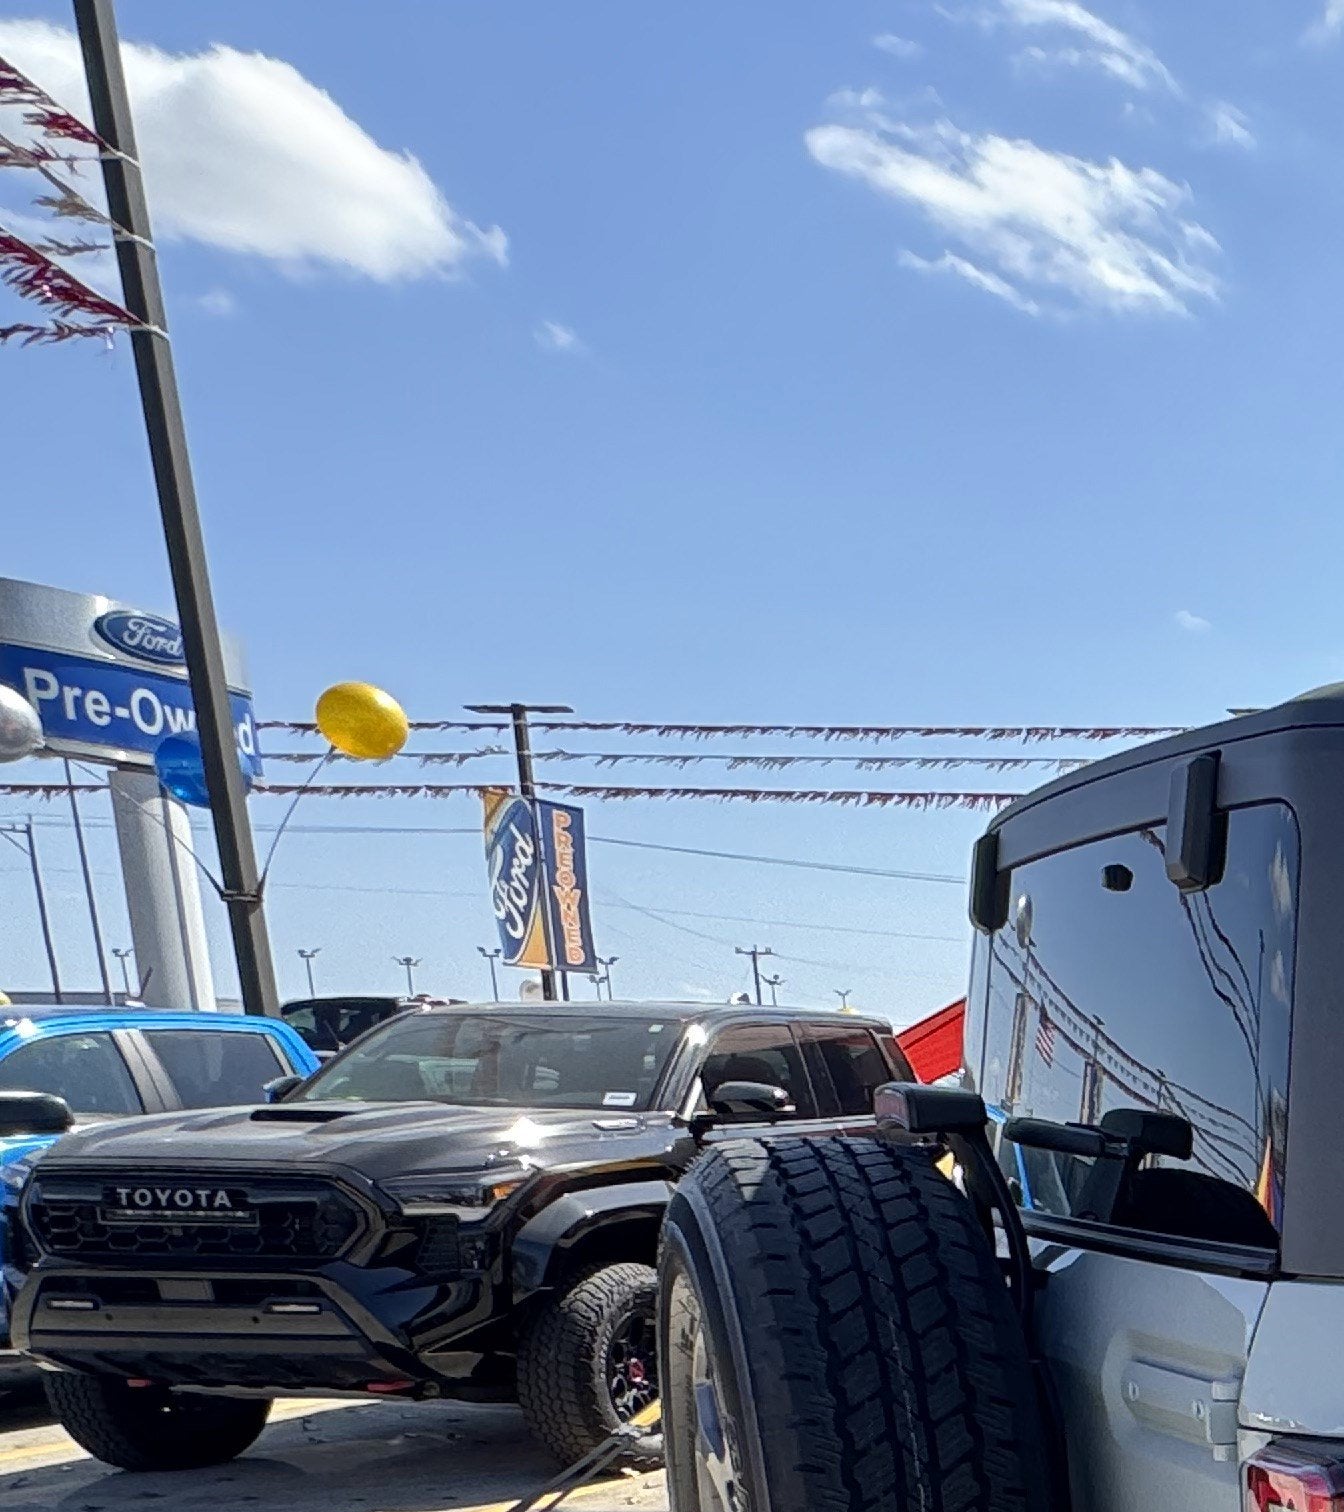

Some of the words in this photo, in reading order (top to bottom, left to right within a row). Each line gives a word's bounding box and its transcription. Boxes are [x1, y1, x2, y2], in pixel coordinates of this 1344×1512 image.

[123, 618, 183, 656] Ford
[492, 822, 535, 939] Ford
[116, 1187, 232, 1208] TOYOTA
